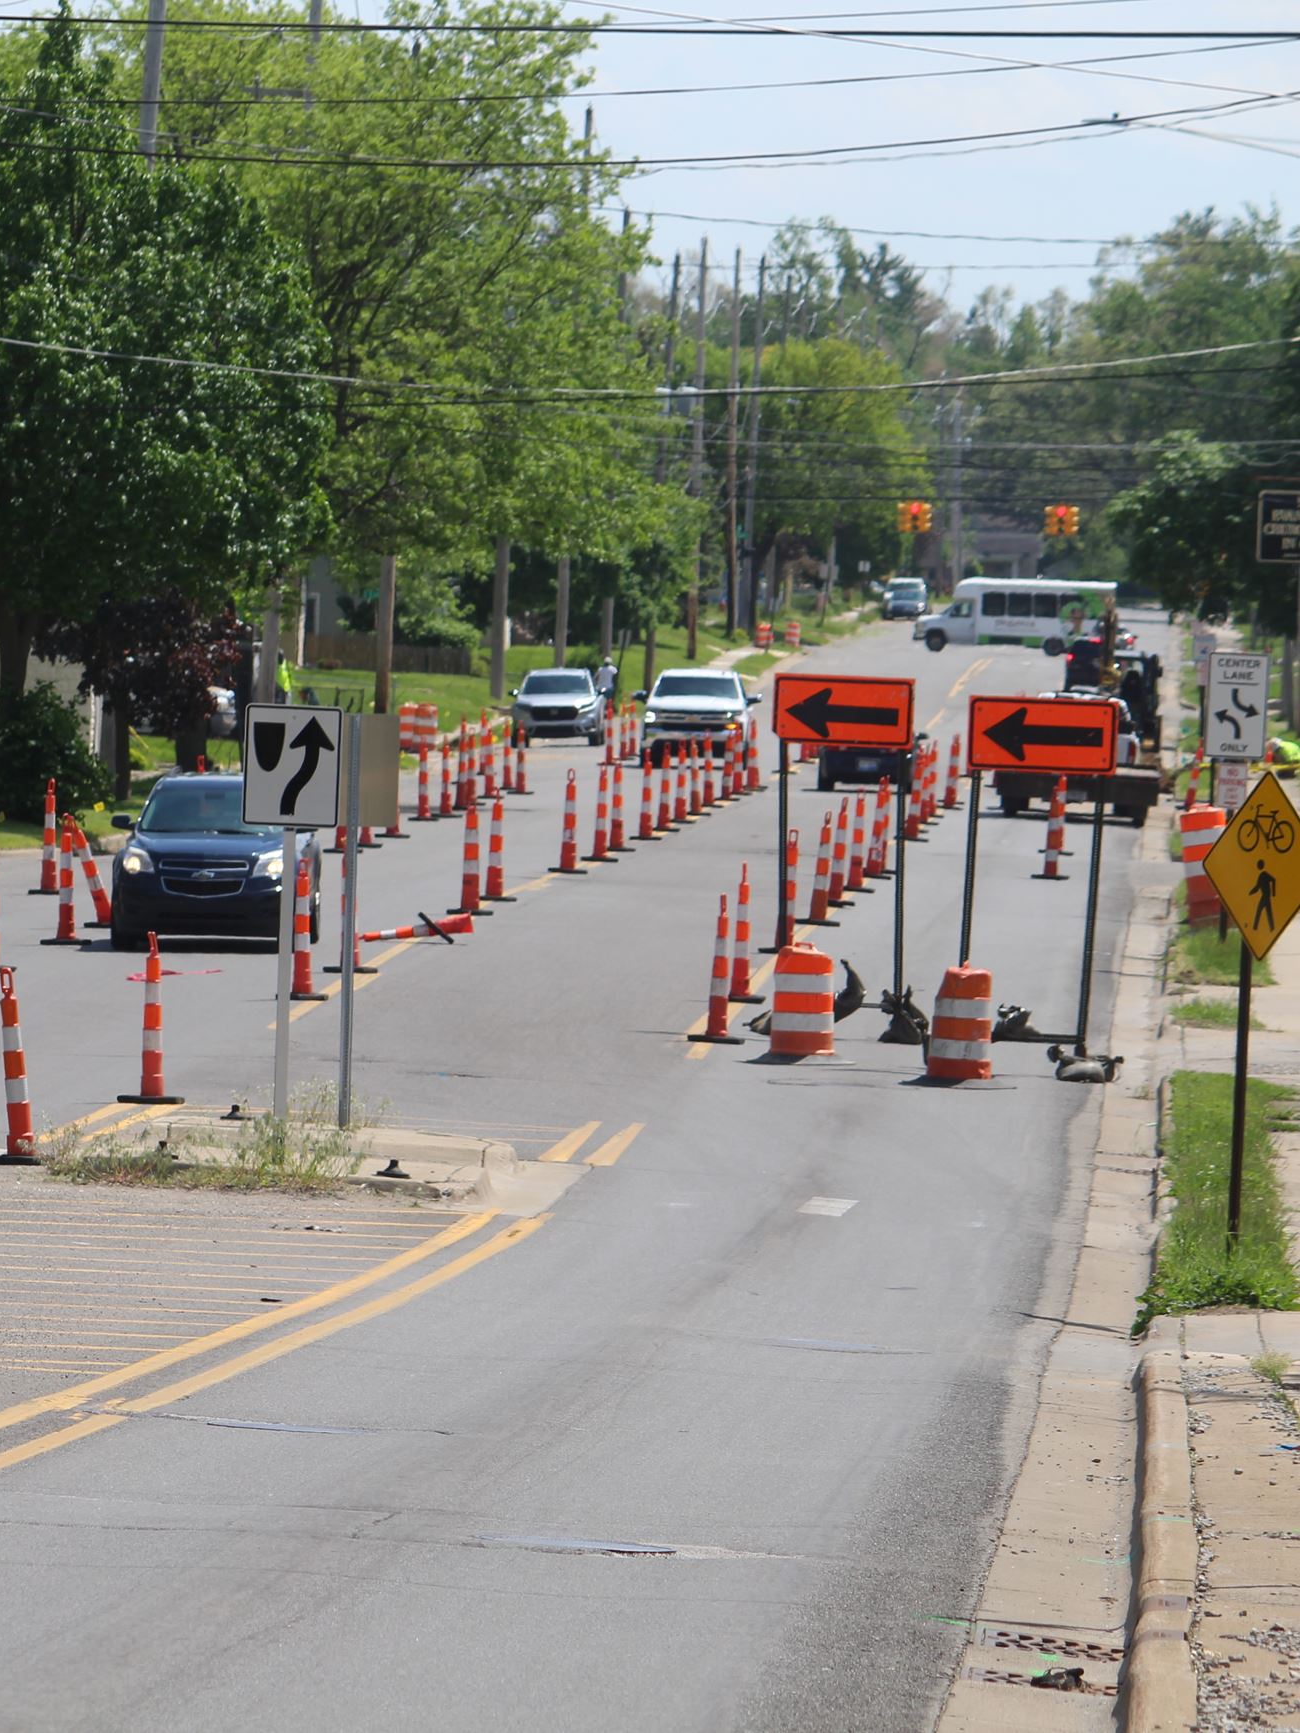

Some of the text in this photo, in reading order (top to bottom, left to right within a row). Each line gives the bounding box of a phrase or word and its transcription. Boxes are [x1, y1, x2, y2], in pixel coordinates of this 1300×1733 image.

[1217, 658, 1261, 669] CENTER
[1223, 671, 1254, 681] LANE
[1220, 742, 1249, 753] ONLY
